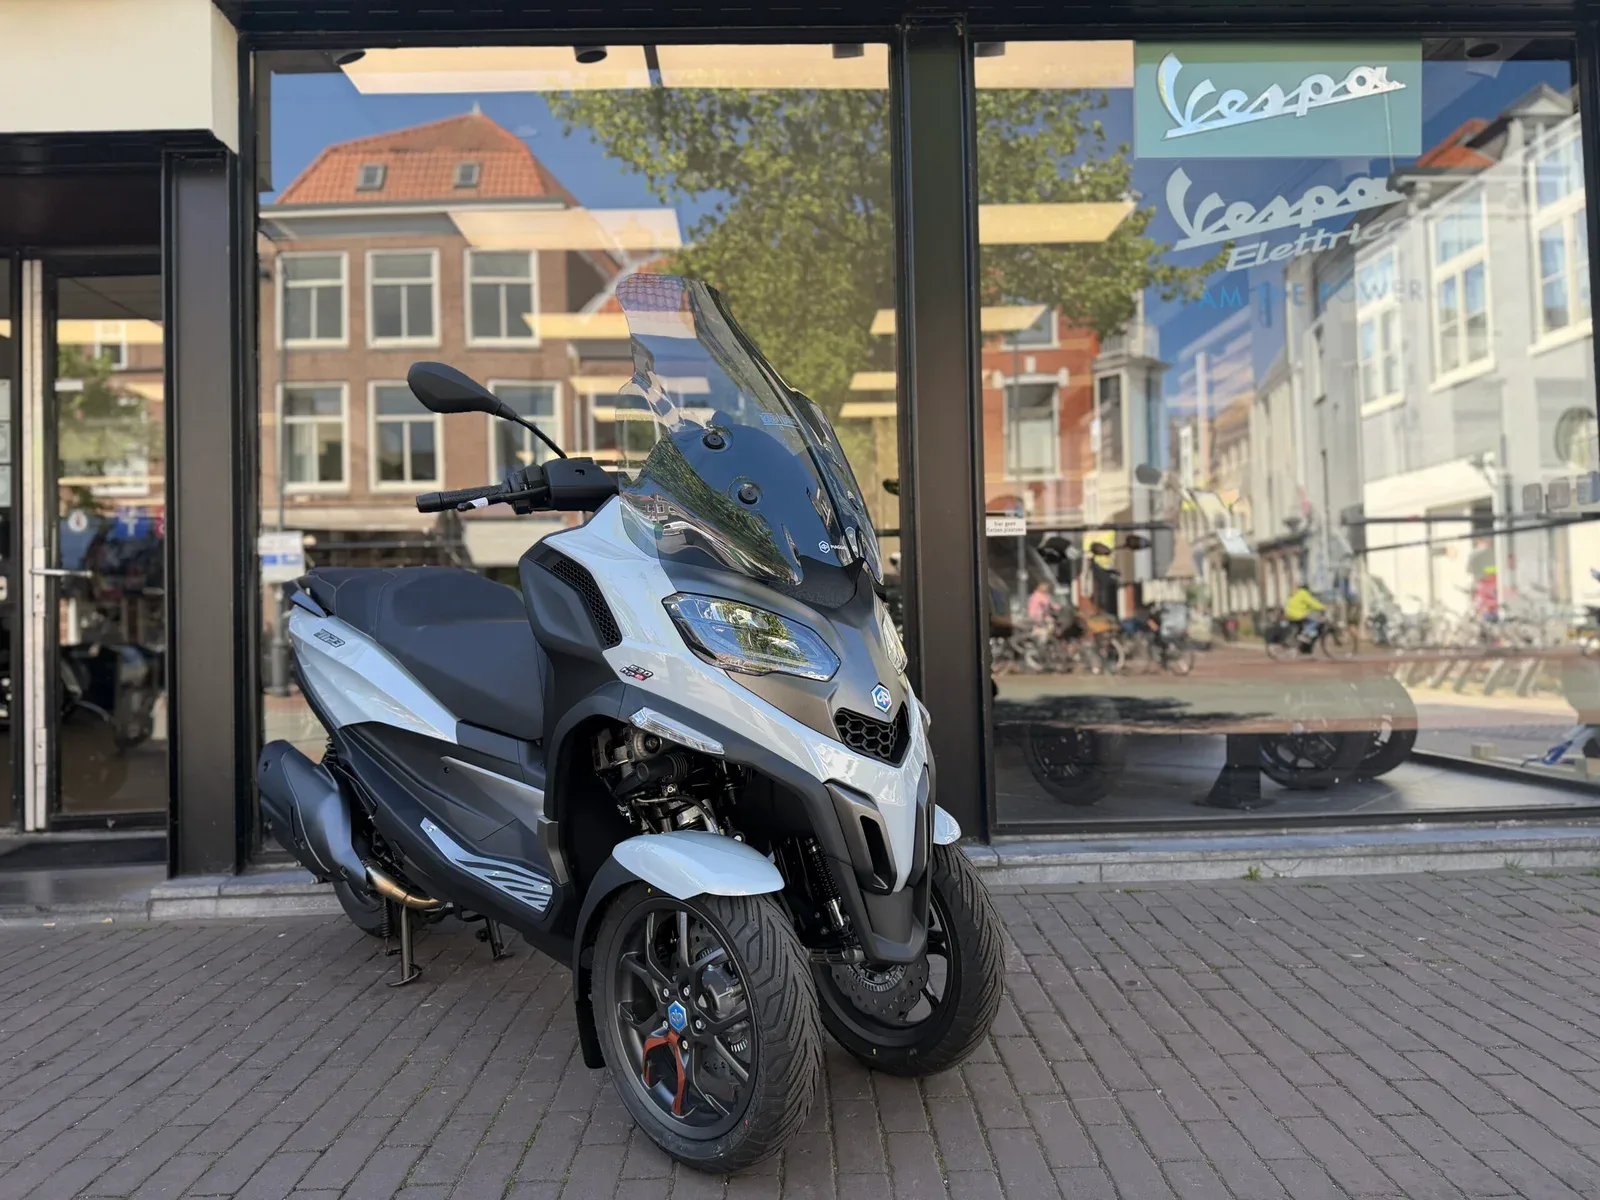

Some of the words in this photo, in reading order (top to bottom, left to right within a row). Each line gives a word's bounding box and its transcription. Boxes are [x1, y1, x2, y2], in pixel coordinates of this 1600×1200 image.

[1156, 51, 1407, 141] Vespa
[1165, 167, 1407, 252] Vespa
[1197, 286, 1243, 309] AM
